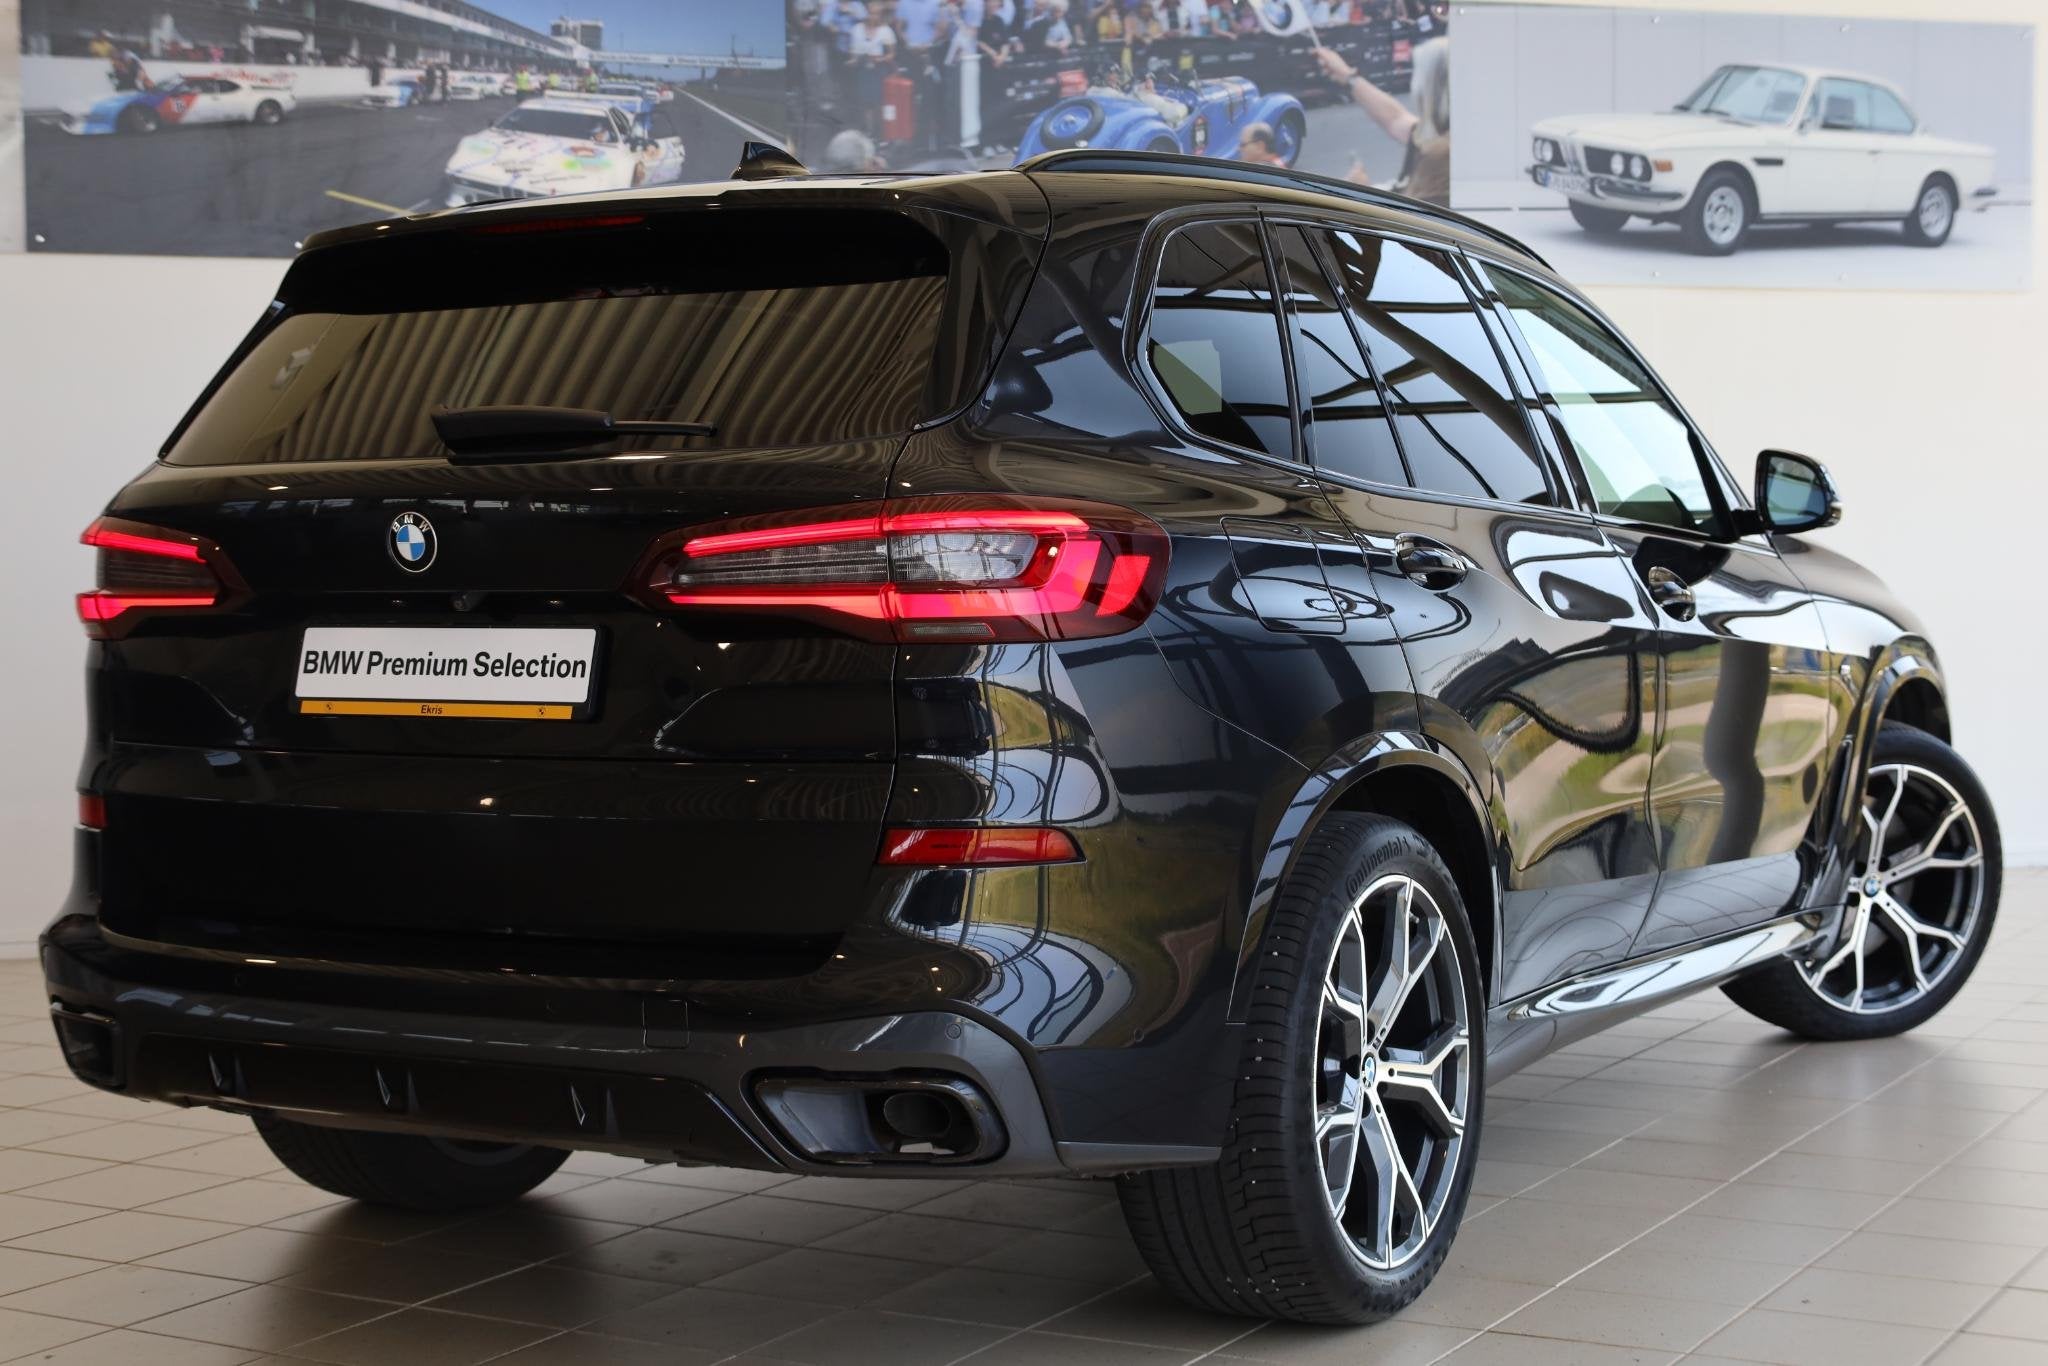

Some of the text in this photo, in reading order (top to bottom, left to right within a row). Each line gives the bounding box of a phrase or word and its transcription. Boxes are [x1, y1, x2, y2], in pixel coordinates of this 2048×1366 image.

[392, 514, 430, 532] BMW
[303, 650, 587, 678] BMW Premium Selection
[420, 705, 443, 715] Ekris
[1345, 836, 1402, 901] Continental
